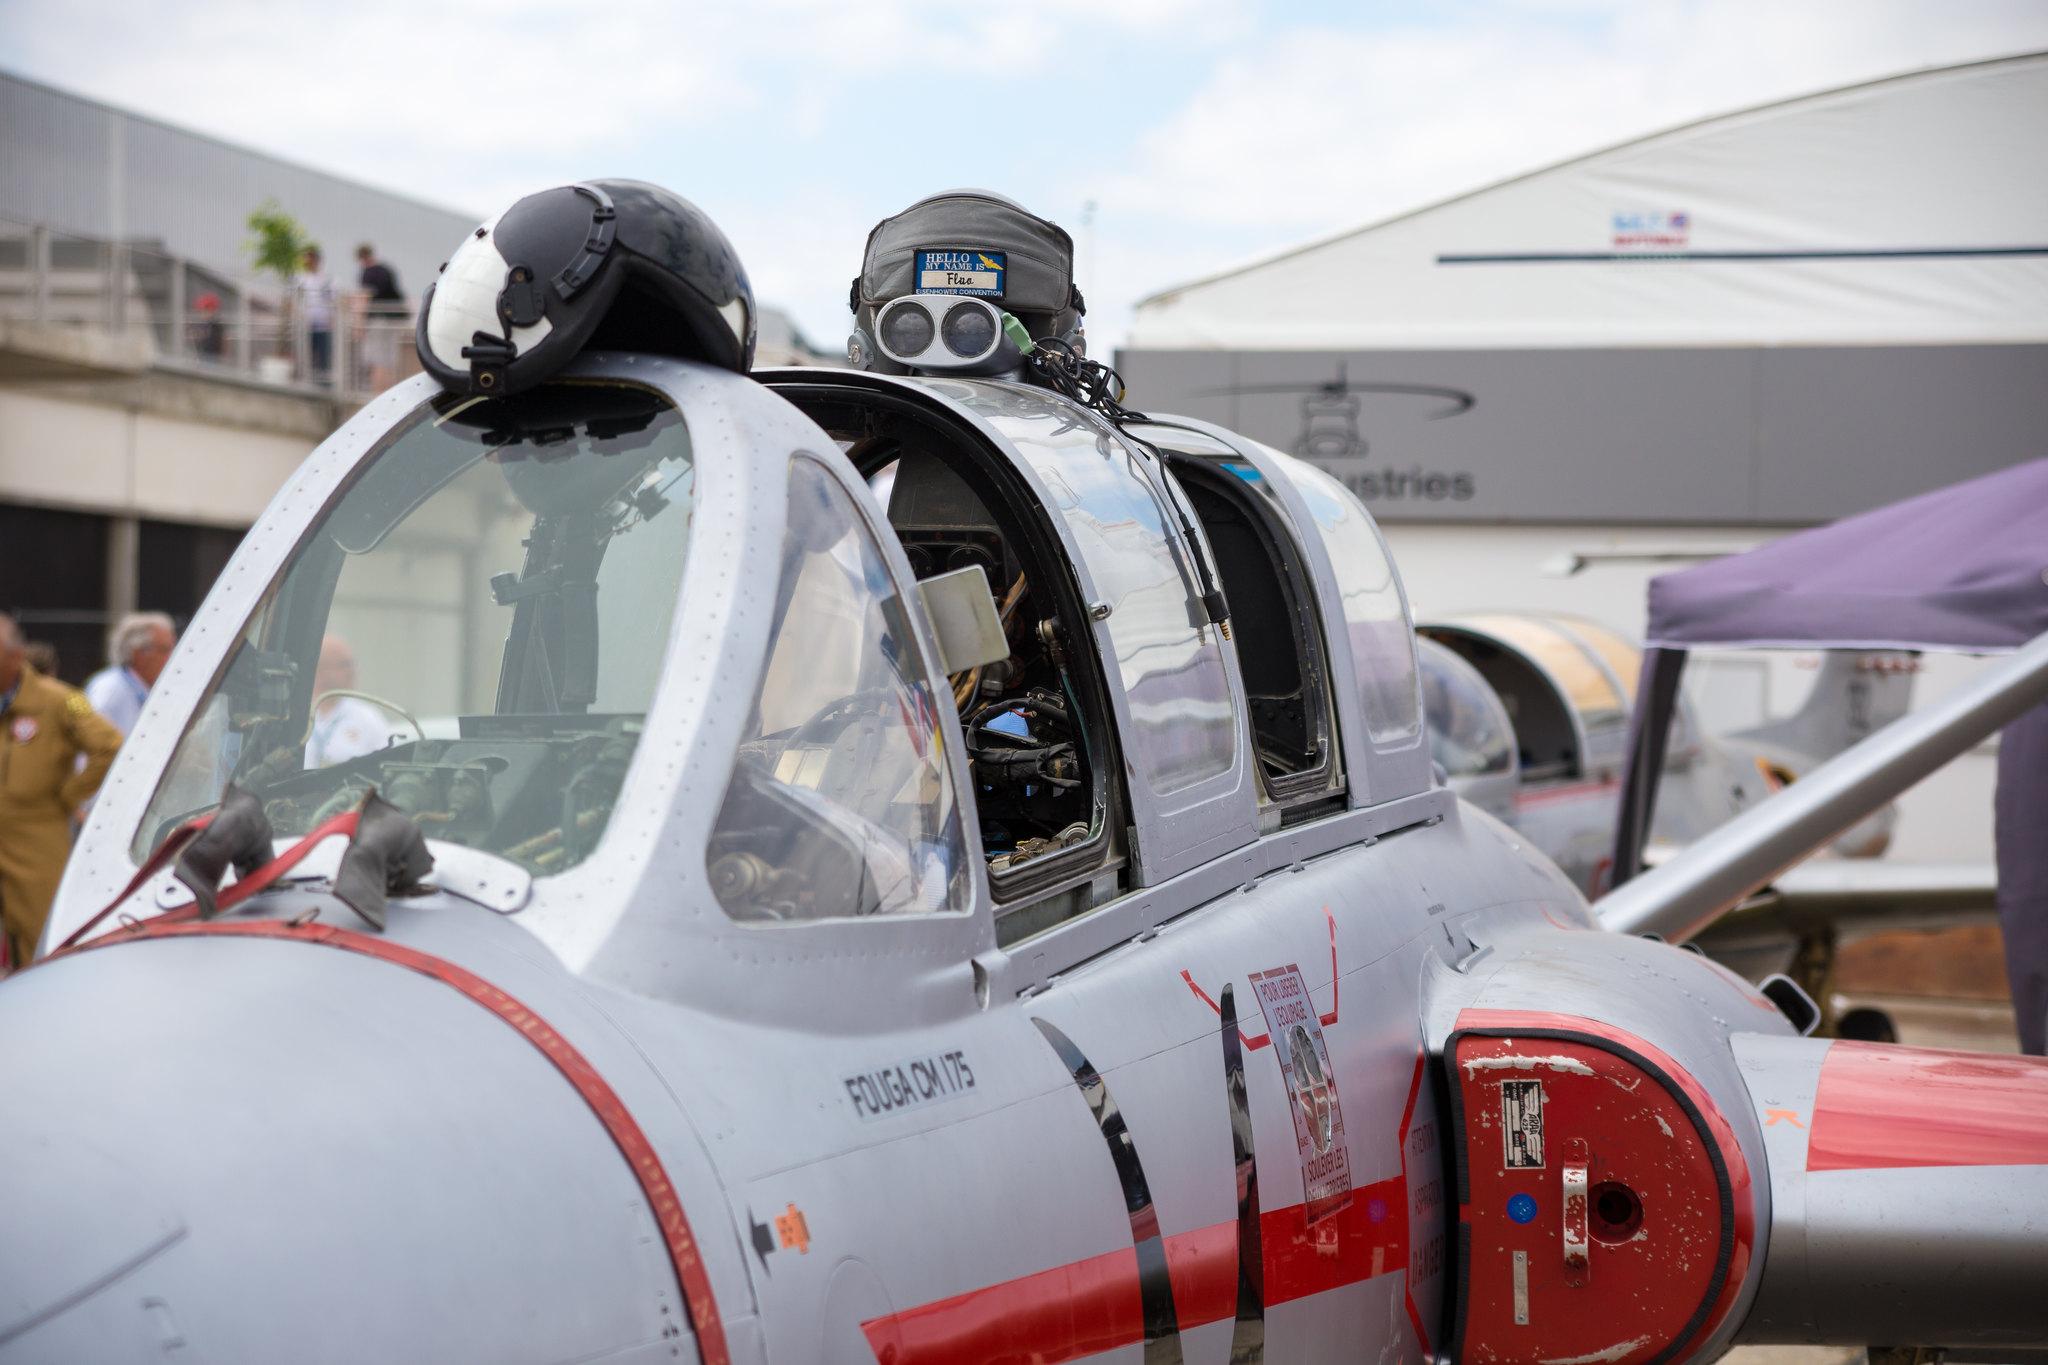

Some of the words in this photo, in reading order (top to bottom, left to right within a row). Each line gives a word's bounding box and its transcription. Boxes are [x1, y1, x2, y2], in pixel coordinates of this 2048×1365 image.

[926, 253, 970, 263] HELLO
[925, 262, 939, 270] MY
[946, 272, 975, 285] Fluo
[916, 288, 958, 296] EISENHOWER
[959, 289, 1003, 297] CONVENTION
[844, 1064, 919, 1118] FOUGA
[910, 1058, 946, 1100] CM
[938, 1050, 976, 1093] 175
